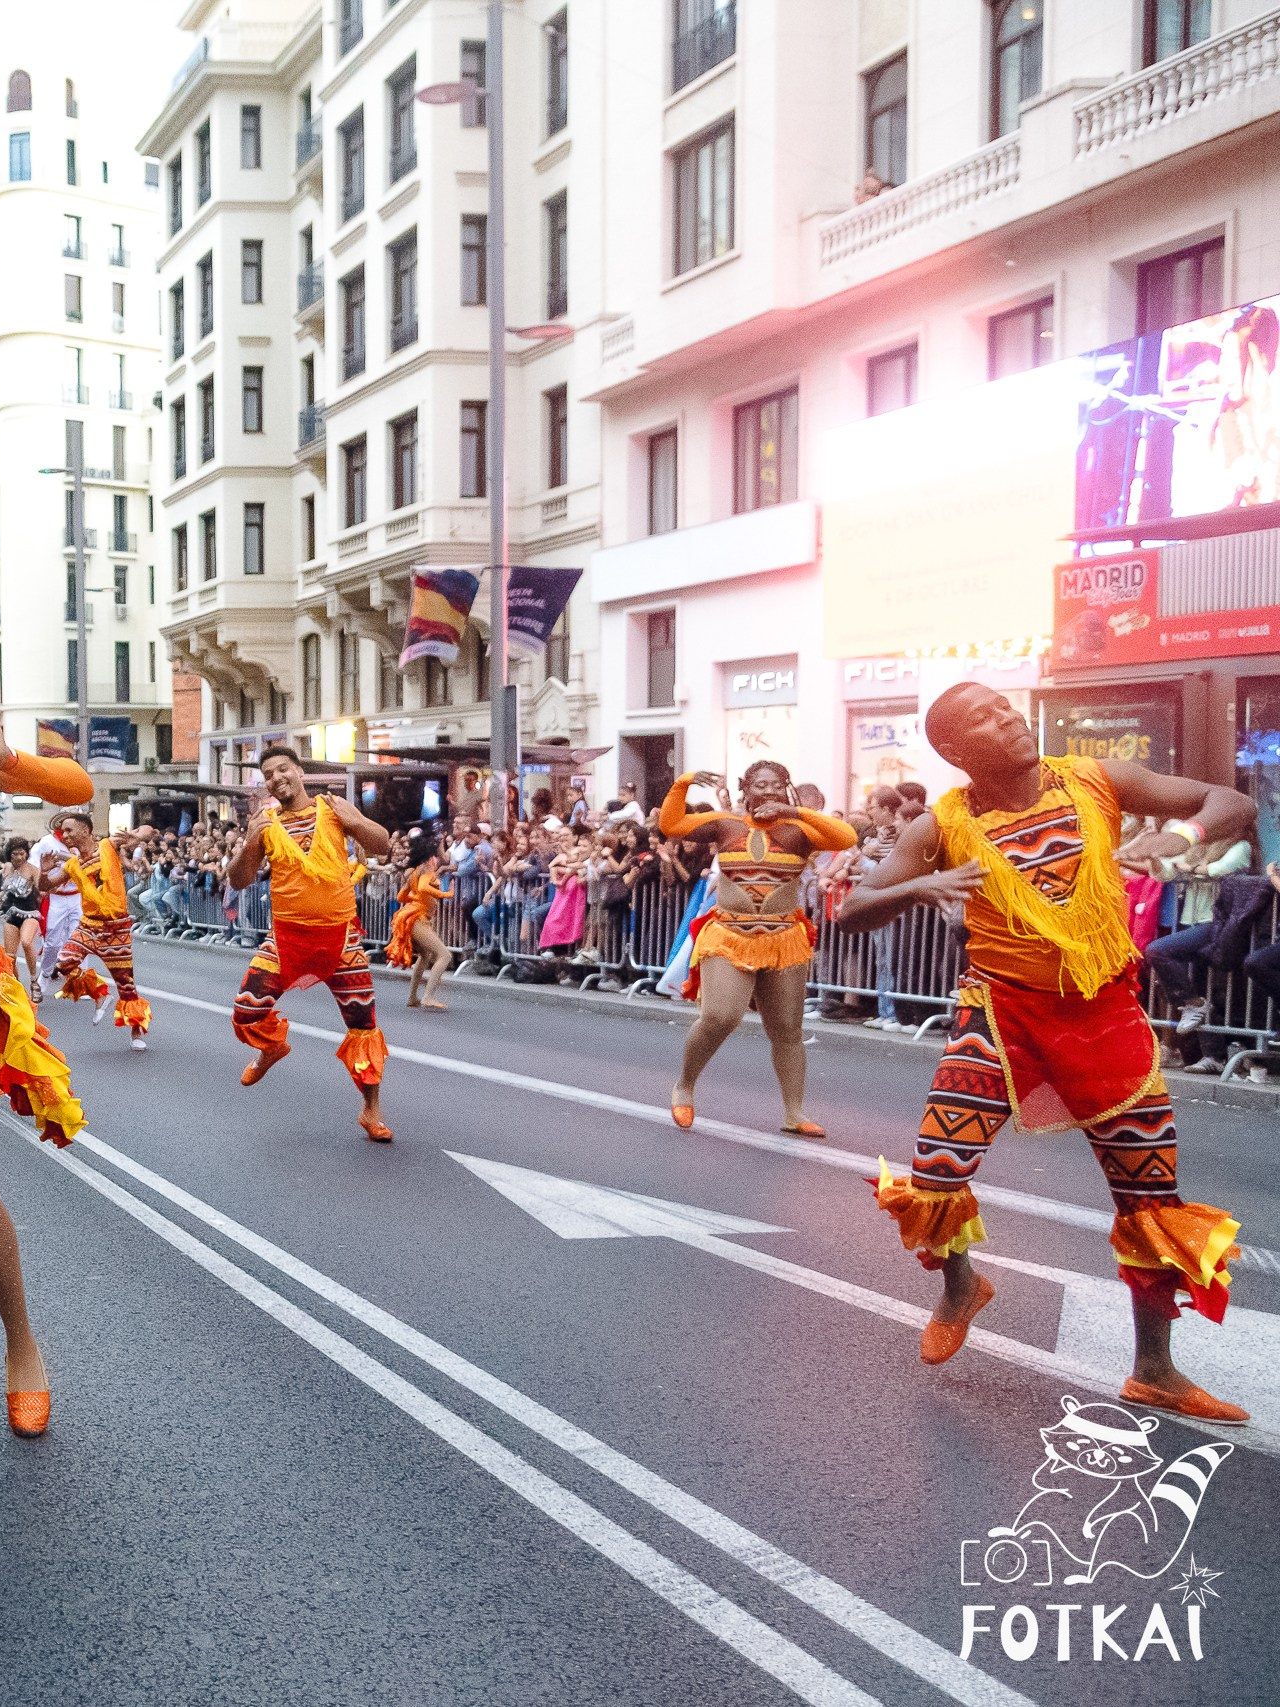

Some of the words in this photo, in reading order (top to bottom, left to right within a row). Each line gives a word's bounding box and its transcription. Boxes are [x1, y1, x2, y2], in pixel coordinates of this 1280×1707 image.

[1061, 561, 1146, 598] MADRID
[508, 598, 545, 609] CIONAL
[1171, 630, 1210, 643] MADRID
[733, 670, 794, 693] FICH
[844, 660, 919, 683] FICH
